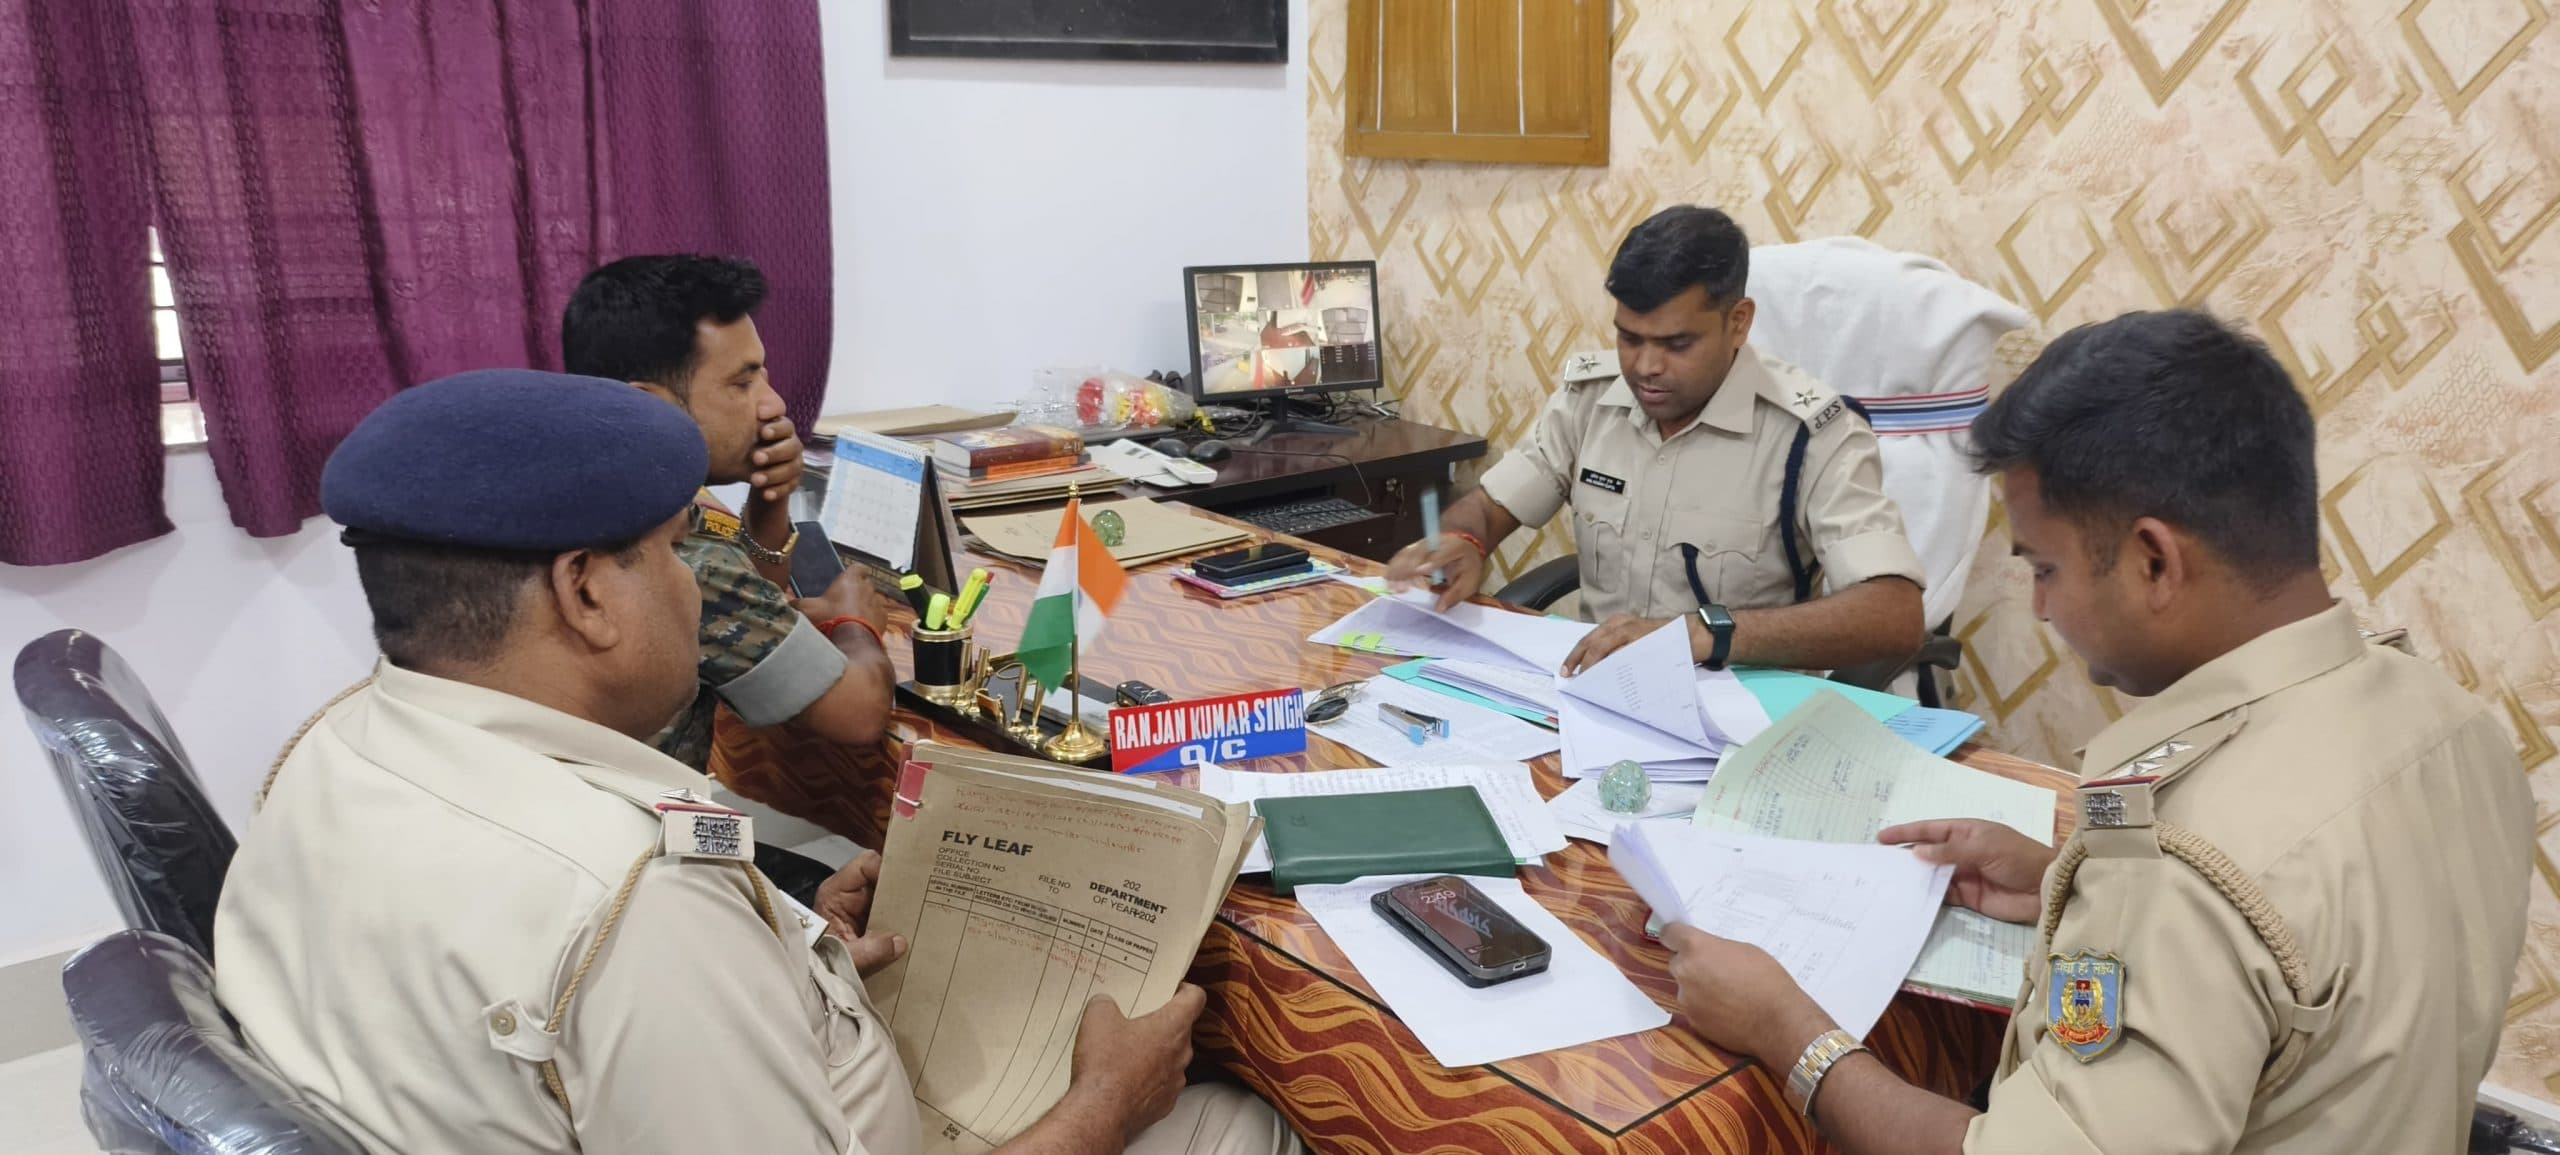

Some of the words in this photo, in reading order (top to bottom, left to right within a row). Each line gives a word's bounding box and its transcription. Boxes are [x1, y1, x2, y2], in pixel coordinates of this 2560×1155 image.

[1189, 700, 1251, 740] KUMAR
[1253, 694, 1305, 733] SINGH
[1179, 738, 1247, 766] O/C
[942, 830, 978, 845] FLY
[983, 837, 1034, 856] LEAF
[938, 847, 971, 857] OFFICE
[935, 861, 965, 872] SERIAL
[936, 854, 991, 870] COLLECTION
[933, 867, 951, 876] FILE
[953, 870, 992, 884] SUBJECT
[1038, 874, 1057, 886] FILE
[1058, 880, 1071, 889] NO
[1048, 885, 1060, 894] TO
[1123, 879, 1142, 892] 202
[1089, 881, 1168, 914] DEPARTMENT
[1093, 895, 1108, 905] OF
[1420, 890, 1457, 905] 2:49
